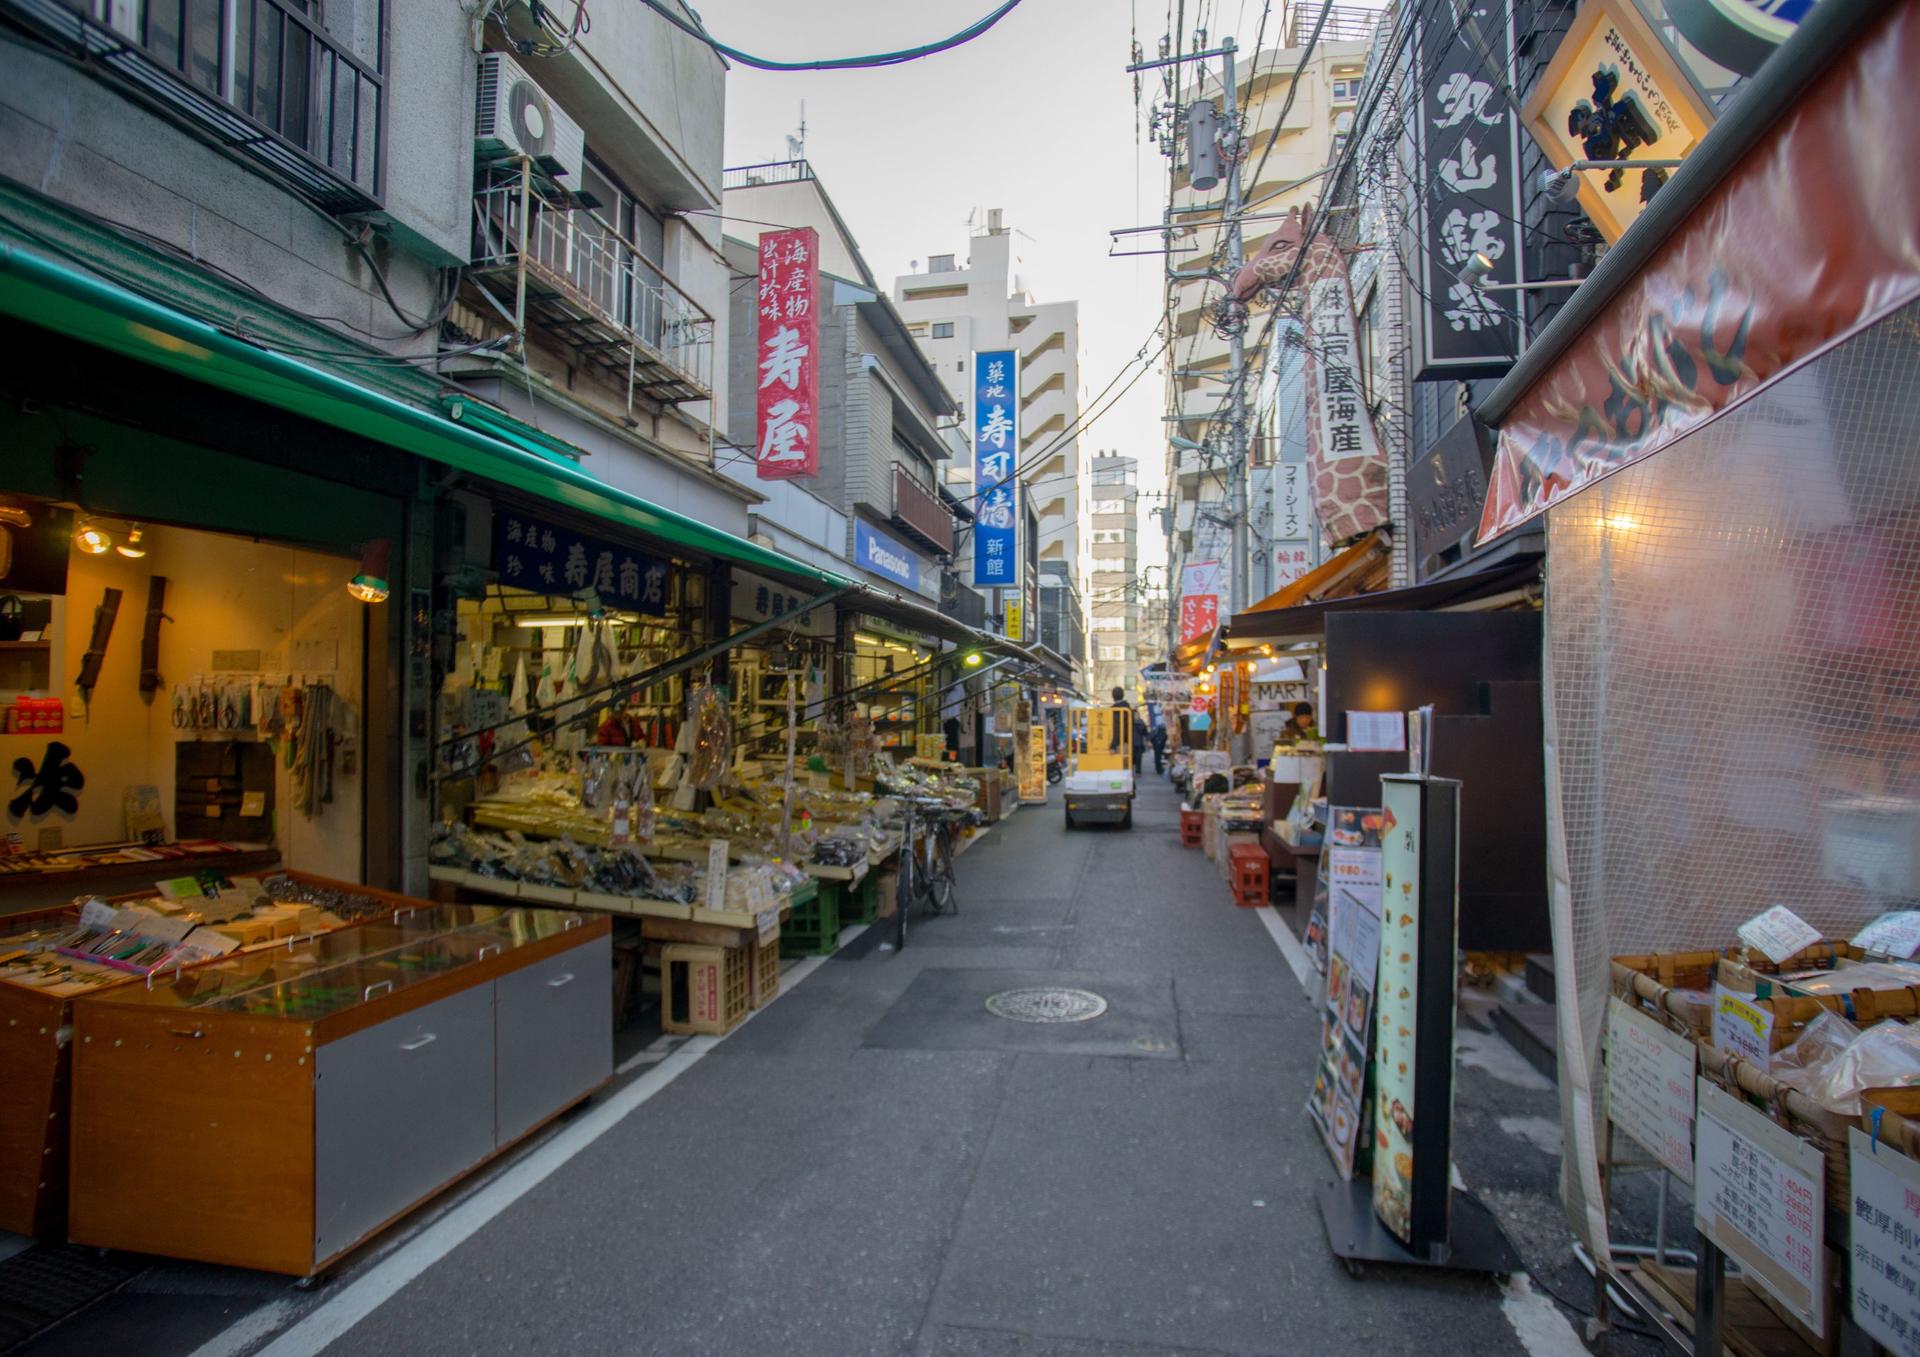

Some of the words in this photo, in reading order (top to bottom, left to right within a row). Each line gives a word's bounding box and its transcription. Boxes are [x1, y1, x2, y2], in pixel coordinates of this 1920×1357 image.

[760, 239, 782, 321] 出汁珍味
[784, 243, 809, 319] 海産物
[759, 325, 810, 462] 寿屋
[986, 361, 1006, 398] 築地
[979, 404, 1014, 530] 寿司清
[1285, 465, 1298, 537] フォーシーズン
[507, 519, 556, 553] 海産物
[868, 536, 909, 578] Panasonic
[986, 538, 1004, 576] 新館
[565, 542, 662, 603] 寿屋商店
[1277, 551, 1290, 590] 輸入
[1258, 683, 1309, 701] MART
